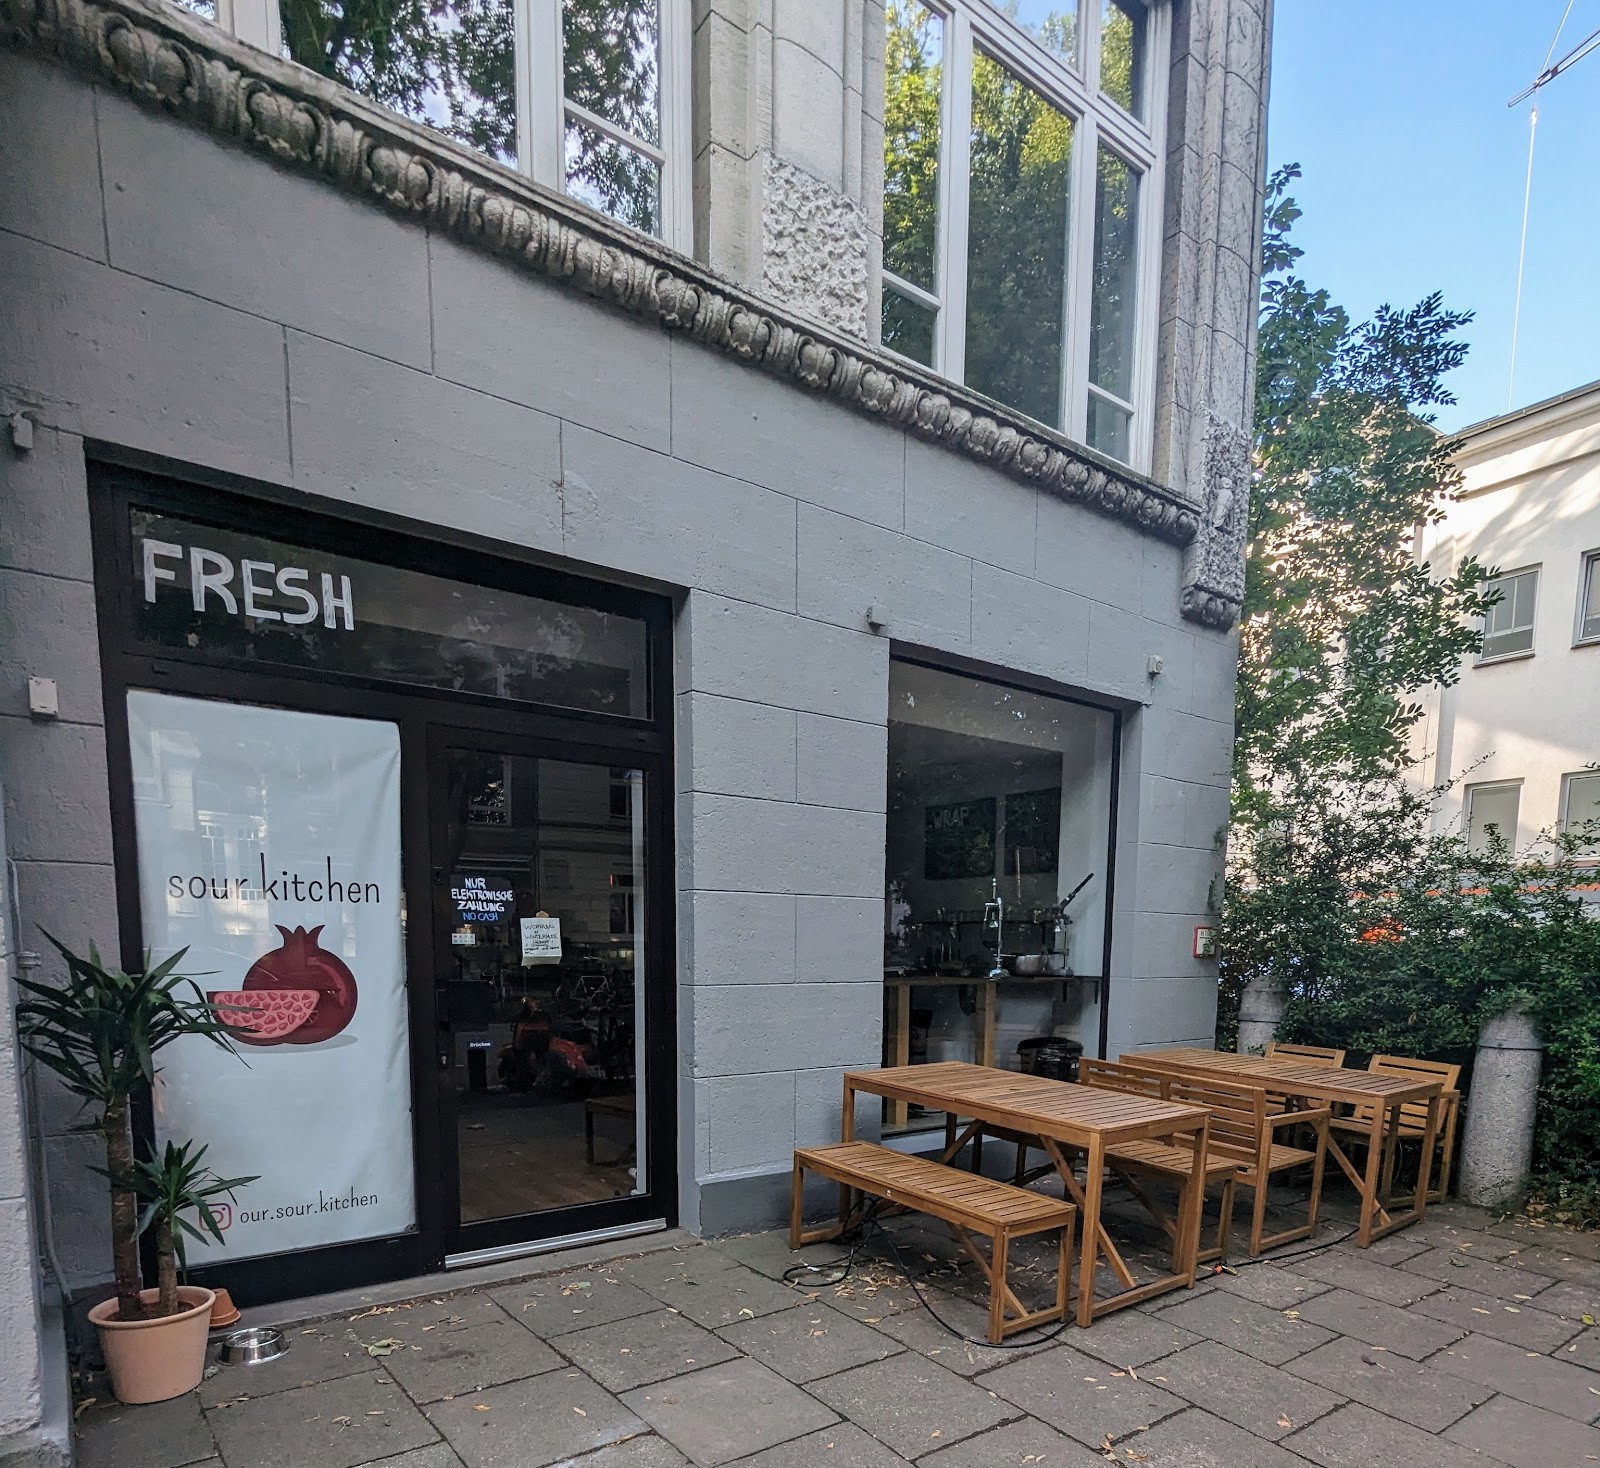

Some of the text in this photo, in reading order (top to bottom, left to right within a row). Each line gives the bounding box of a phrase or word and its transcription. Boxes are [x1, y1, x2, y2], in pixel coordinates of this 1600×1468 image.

[143, 538, 354, 631] FRESH
[168, 852, 380, 903] sour kitchen
[464, 877, 487, 890] NUR
[451, 888, 514, 902] ELEKTRONISCHE
[463, 912, 499, 921] NO CASH
[240, 1186, 378, 1224] our.sour.kitchen
